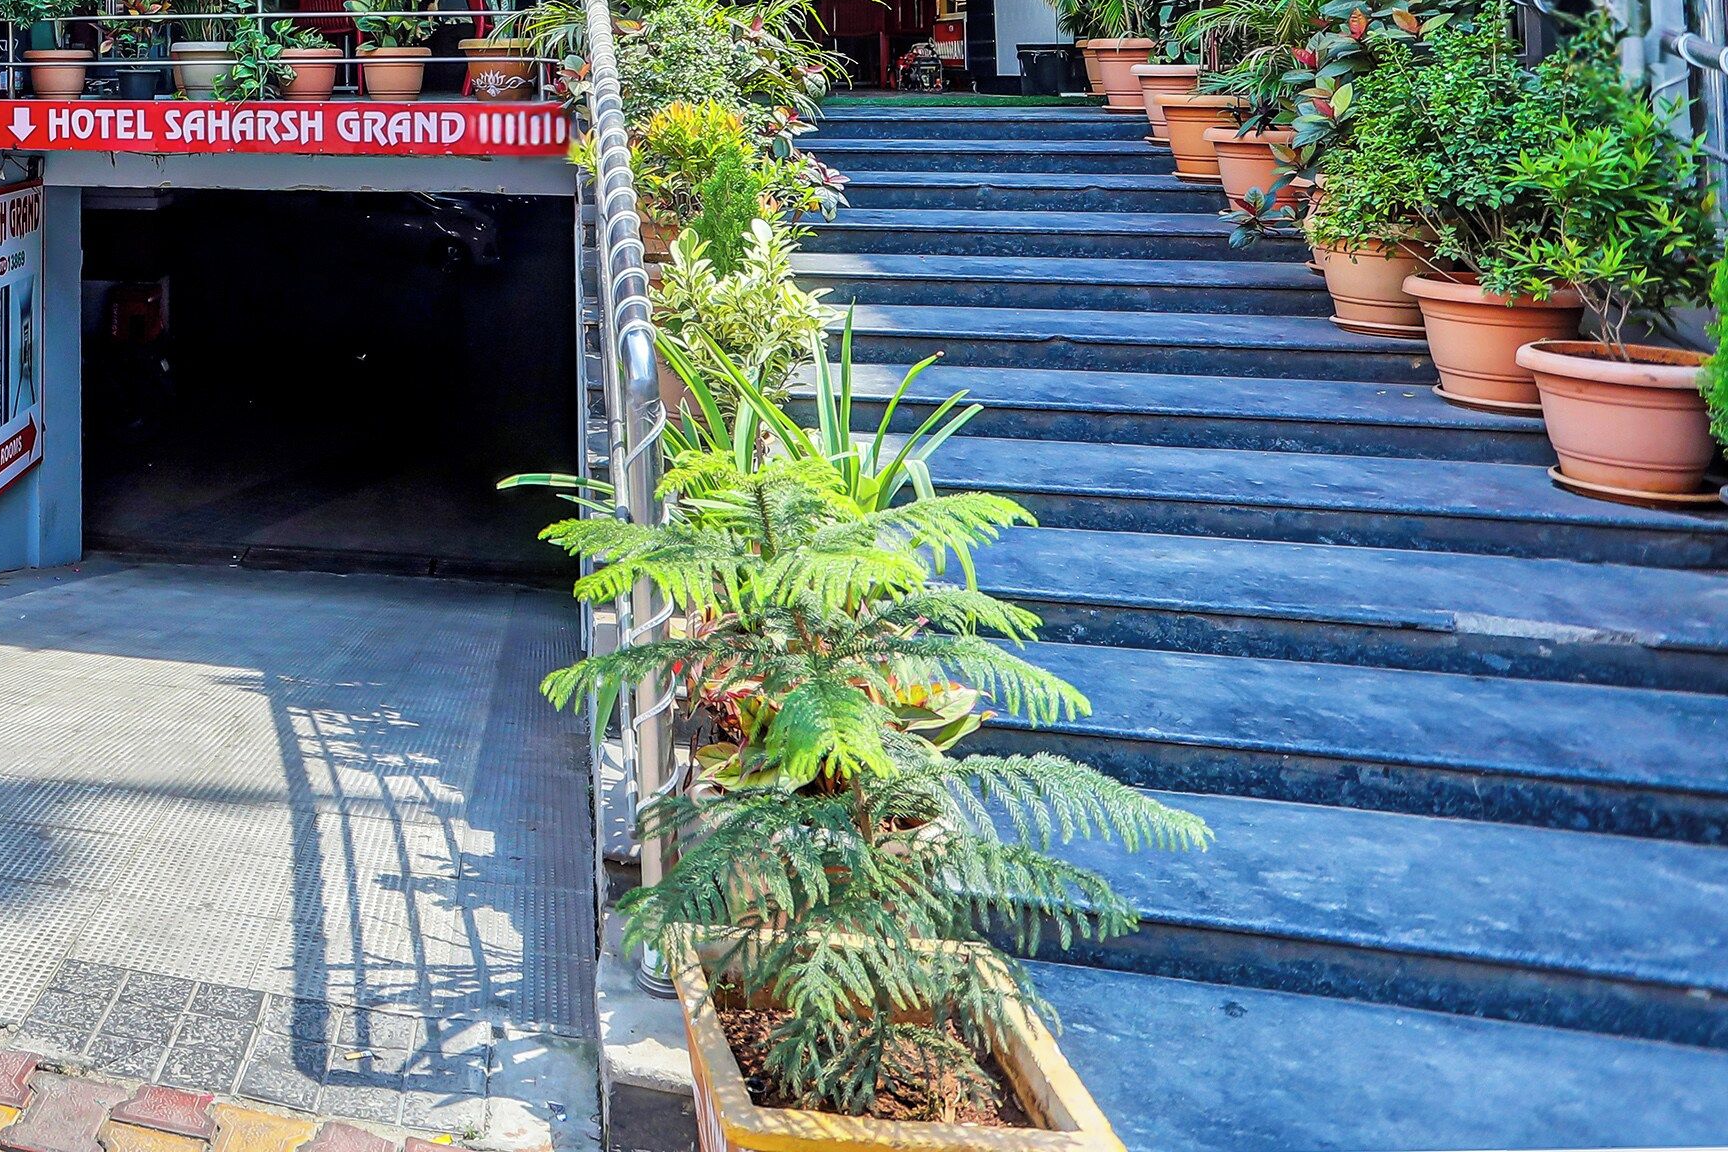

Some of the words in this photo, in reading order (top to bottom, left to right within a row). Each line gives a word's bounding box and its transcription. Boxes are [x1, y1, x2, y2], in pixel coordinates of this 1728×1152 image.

[48, 108, 153, 142] HOTEL
[164, 109, 324, 143] SAHARSH
[336, 110, 467, 147] GRAND
[10, 193, 41, 240] GRAND
[0, 435, 23, 466] ROOMS
